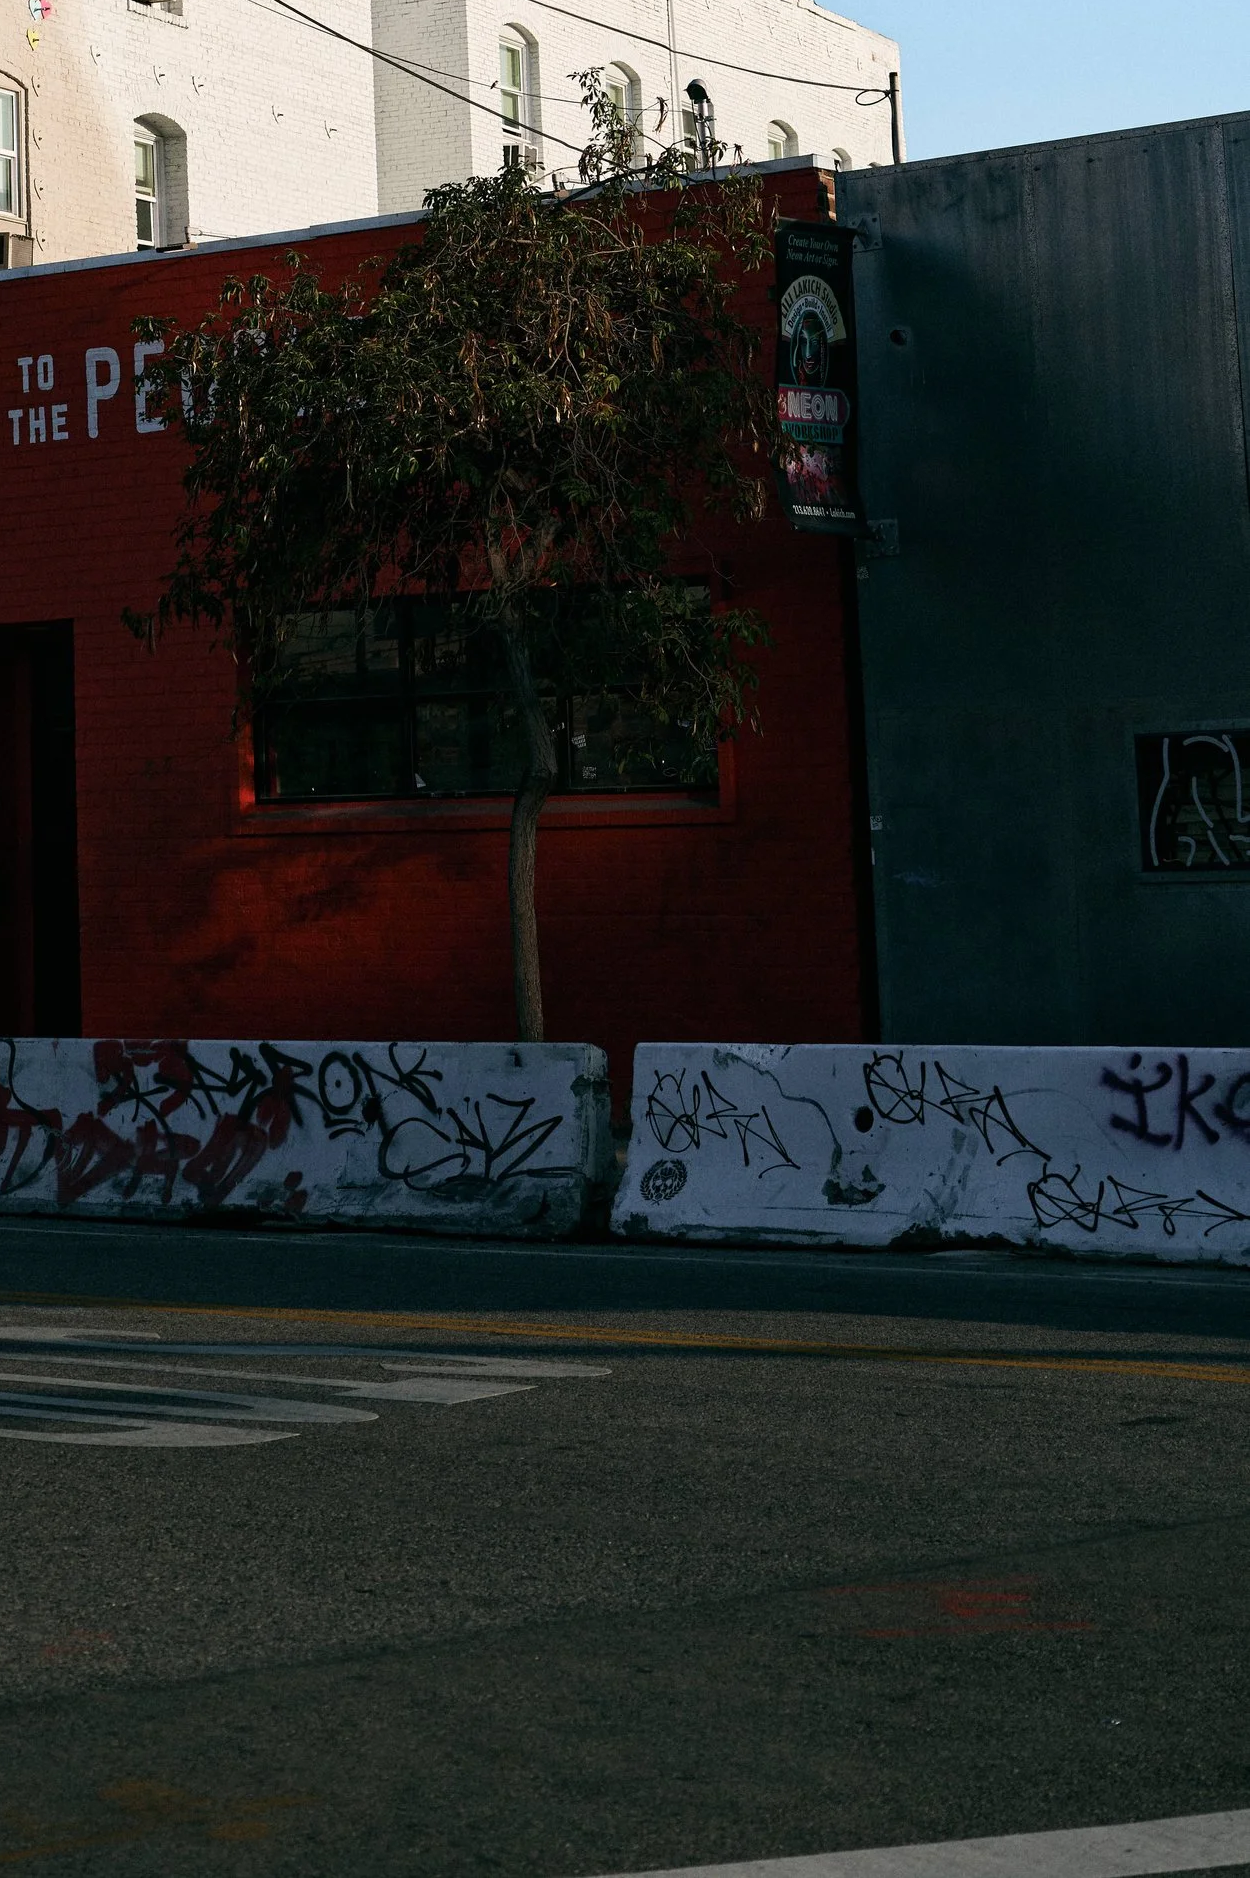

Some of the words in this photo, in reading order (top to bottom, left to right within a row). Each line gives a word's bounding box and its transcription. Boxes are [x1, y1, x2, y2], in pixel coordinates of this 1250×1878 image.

[785, 248, 804, 262] Neon
[803, 253, 815, 263] Art
[815, 256, 823, 264] or
[788, 234, 809, 248] Create
[810, 237, 825, 250] Your
[824, 240, 839, 253] Own
[793, 279, 821, 299] LAKICH
[821, 287, 838, 325] Studio
[17, 354, 54, 393] TO
[787, 390, 838, 422] NEON
[8, 404, 69, 446] THE
[784, 423, 839, 441] WORKSHOP
